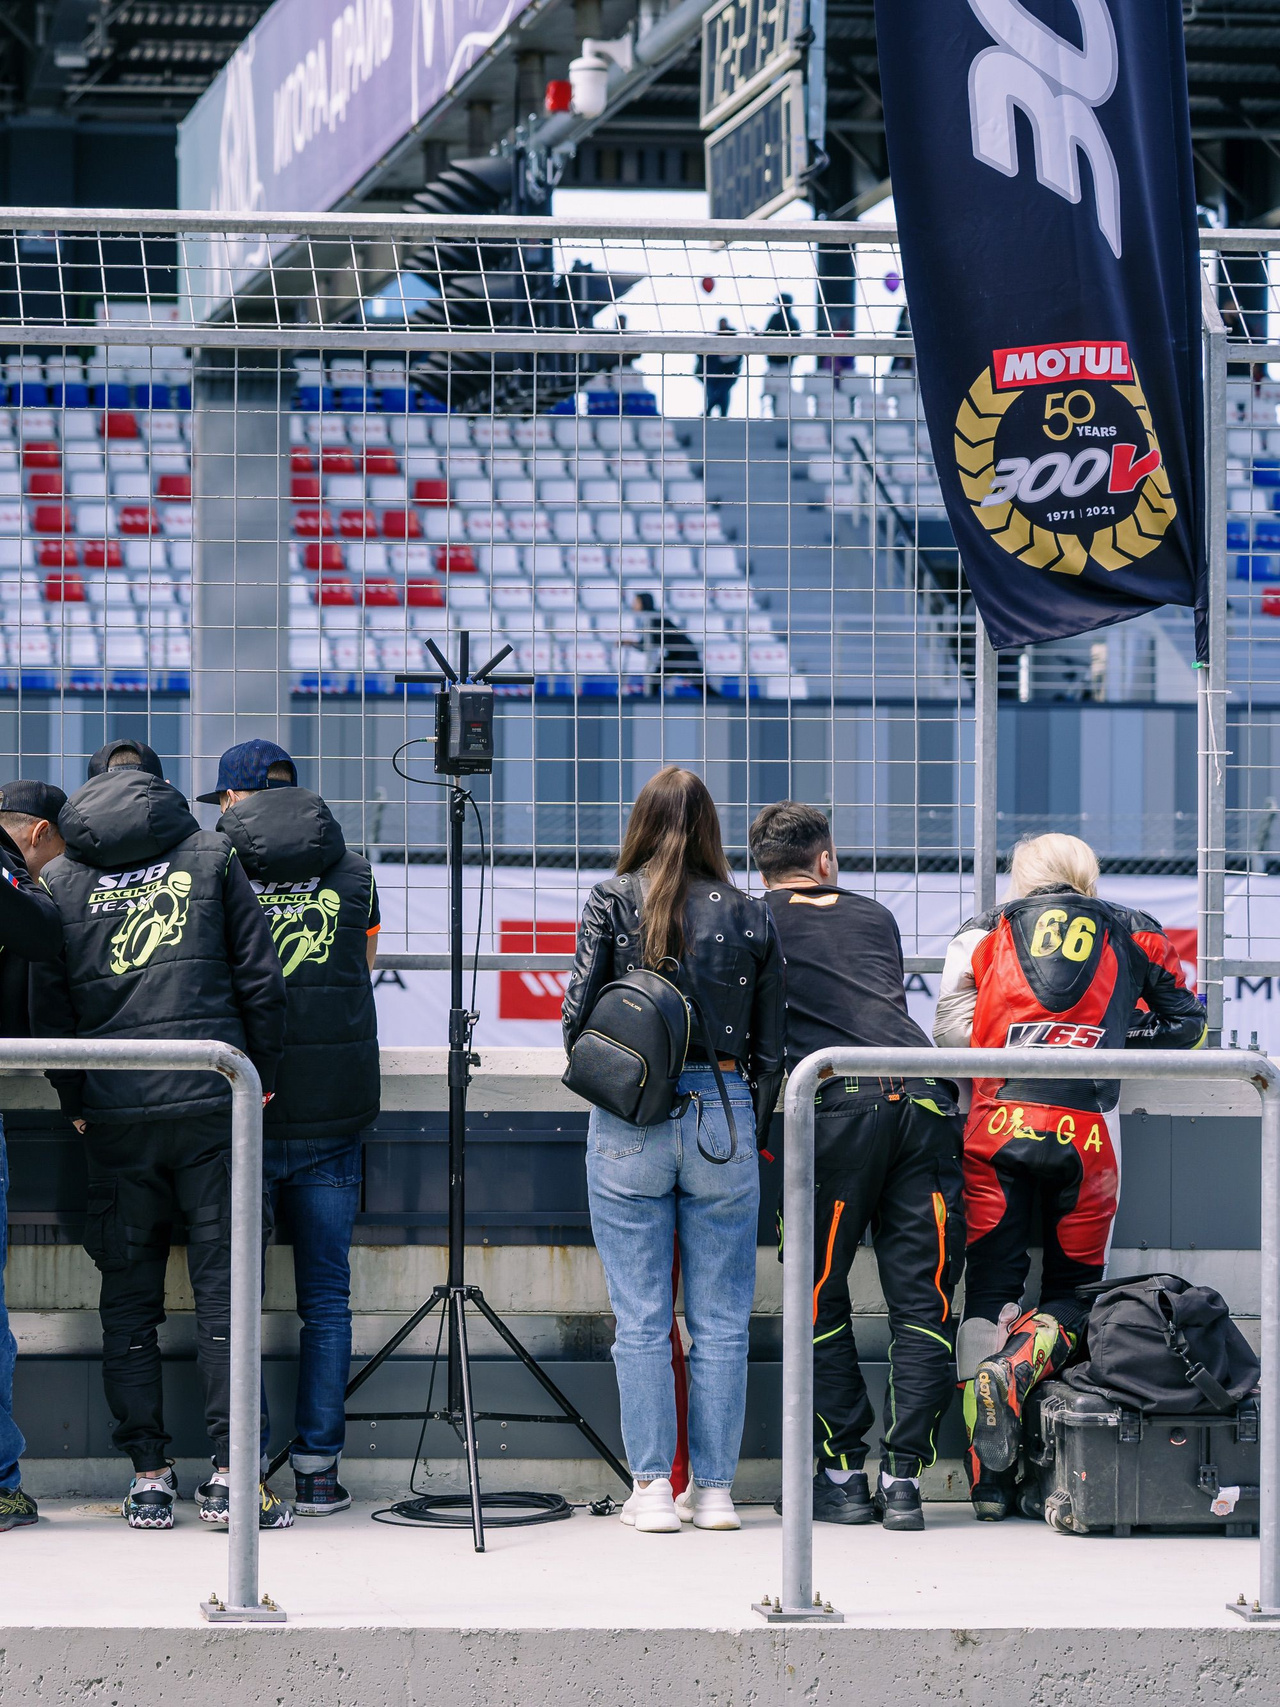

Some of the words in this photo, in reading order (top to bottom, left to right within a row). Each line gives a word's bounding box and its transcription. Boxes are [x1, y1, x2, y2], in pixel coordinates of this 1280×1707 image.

[1002, 347, 1128, 382] MOTUL
[1042, 389, 1096, 441] 50
[1076, 425, 1117, 437] YEARS
[980, 443, 1161, 508] 300V
[1046, 509, 1075, 522] 1971
[1086, 505, 1116, 517] 2021
[93, 861, 171, 892] SPB
[89, 891, 157, 914] TEAM
[94, 883, 158, 901] RACING
[258, 894, 307, 902] ACING
[262, 904, 306, 915] AM
[1030, 909, 1097, 962] 66
[1006, 1022, 1106, 1048] VL65
[894, 1491, 911, 1499] NIKE
